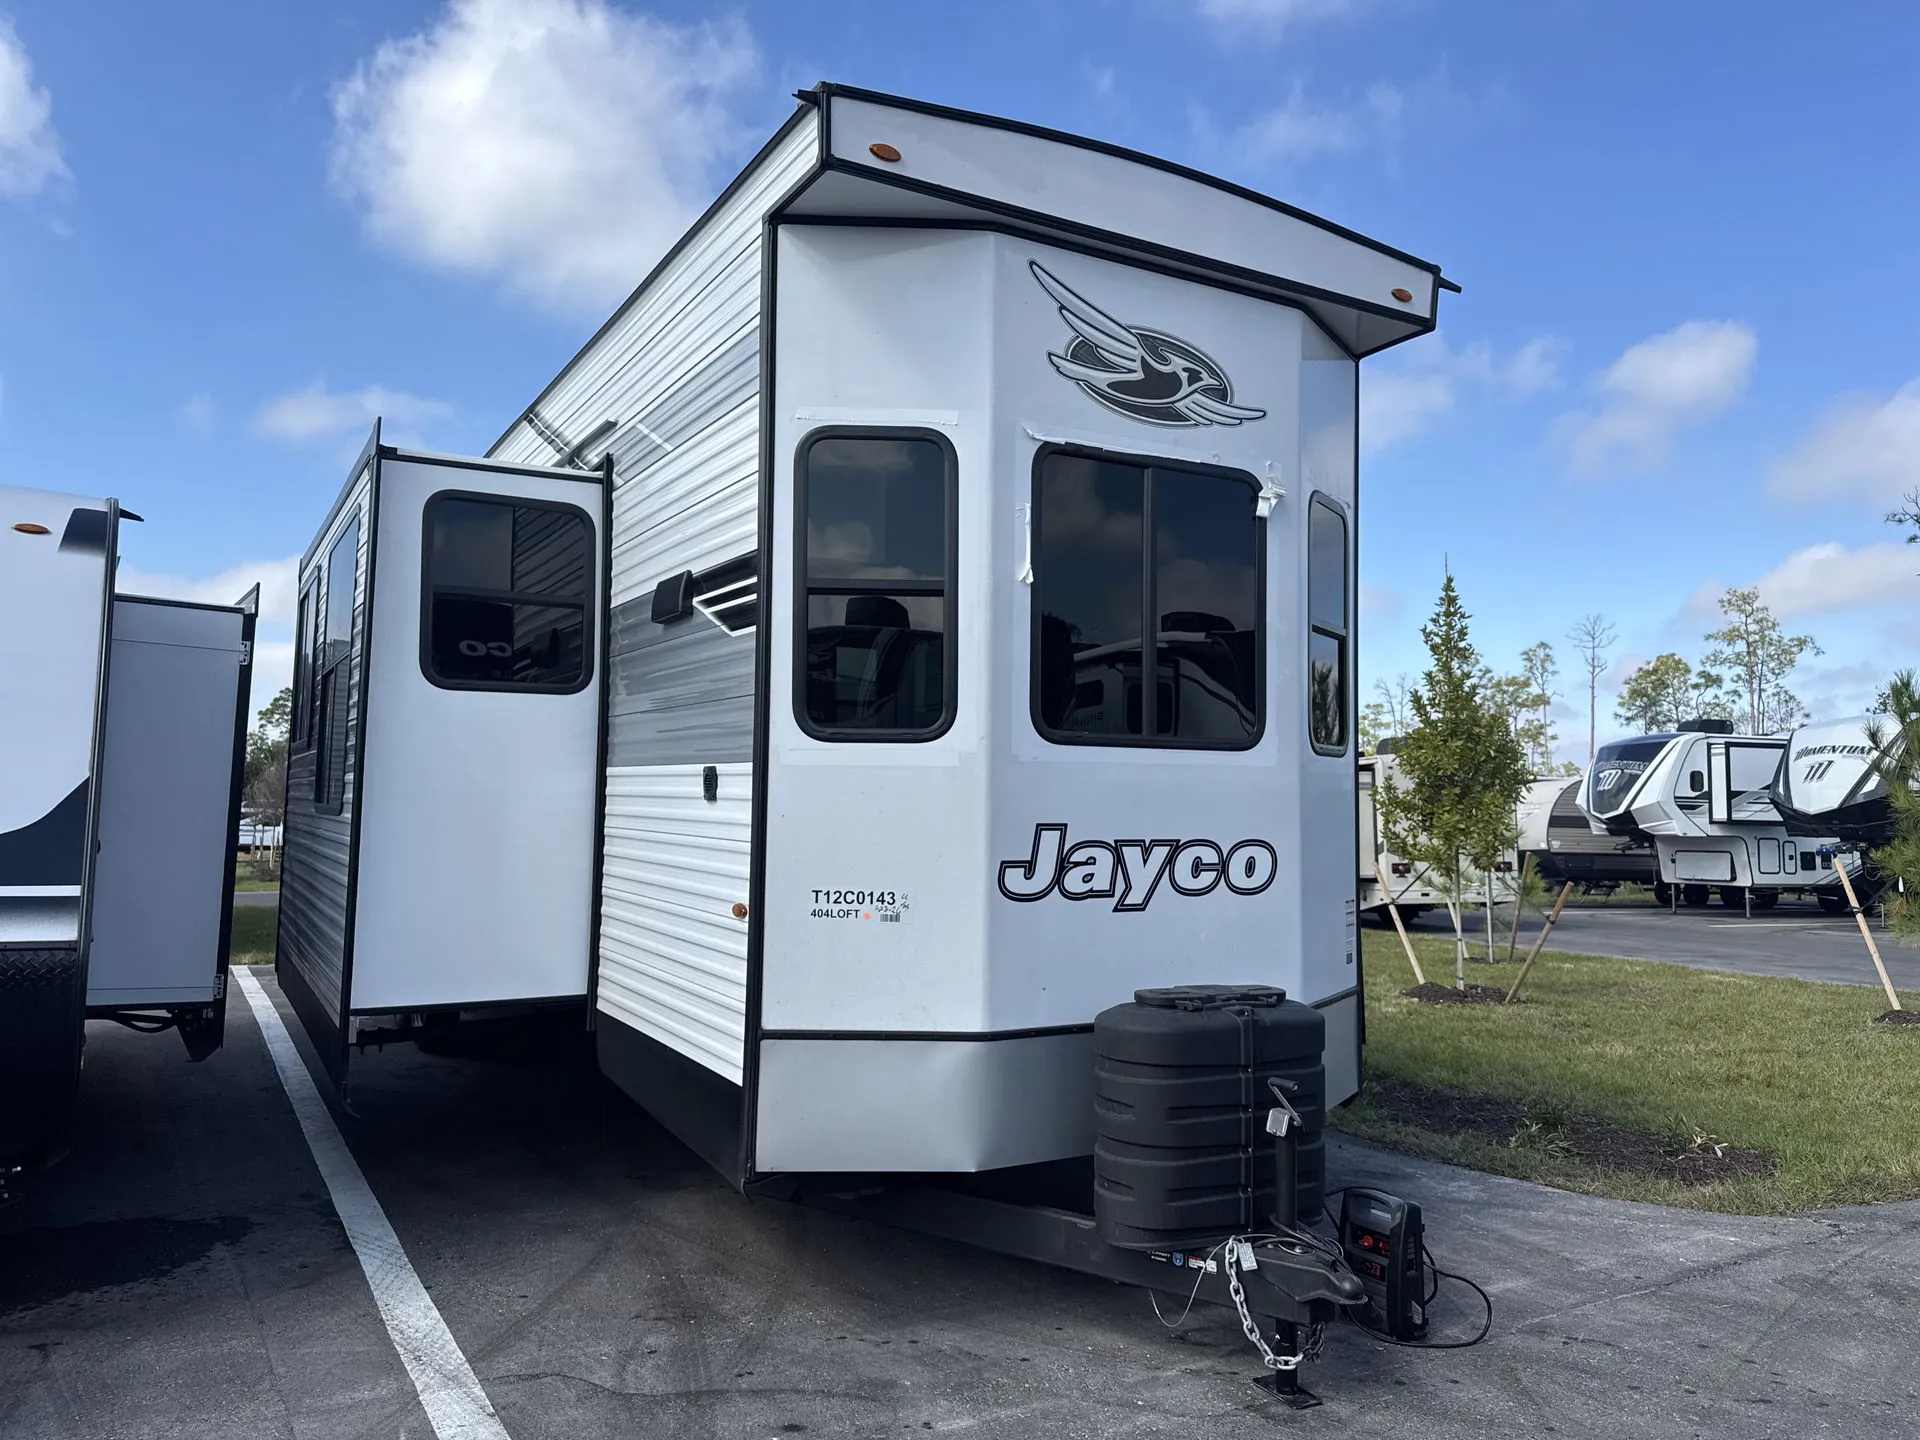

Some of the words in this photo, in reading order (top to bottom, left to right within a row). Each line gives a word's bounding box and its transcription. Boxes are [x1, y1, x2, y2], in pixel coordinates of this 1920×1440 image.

[998, 823, 1278, 912] Jayco
[811, 890, 896, 905] T12C0143
[810, 909, 860, 918] 404LOFT
